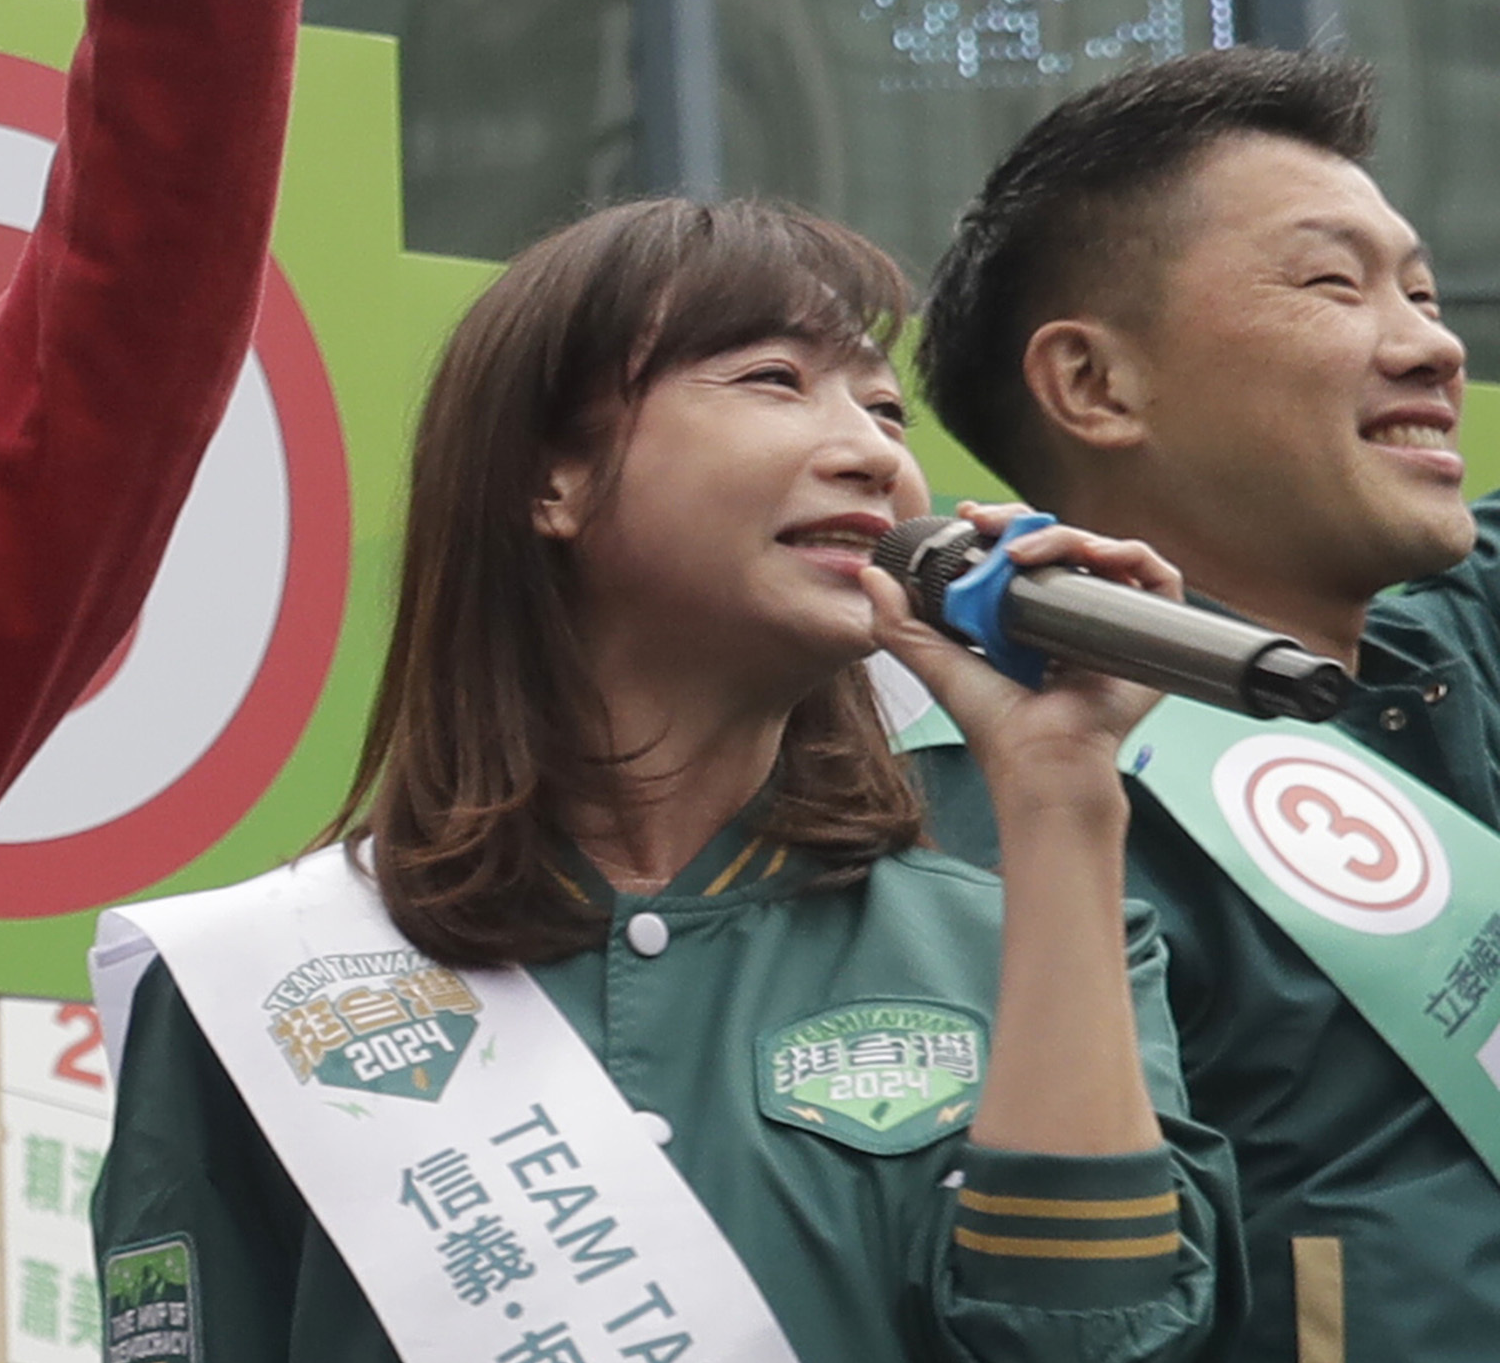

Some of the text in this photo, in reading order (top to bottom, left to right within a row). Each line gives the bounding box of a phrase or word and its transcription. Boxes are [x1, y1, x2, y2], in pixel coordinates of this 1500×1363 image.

[1277, 784, 1398, 884] 3
[262, 958, 336, 1013] TEAM
[53, 1003, 106, 1090] 2
[266, 967, 485, 1086] 挺台灣
[343, 1019, 456, 1083] 2024
[781, 1007, 971, 1046] TEAM TAIWAN
[772, 1030, 981, 1095] 挺台灣
[828, 1070, 931, 1101] 2024
[491, 1103, 635, 1290] TEAM
